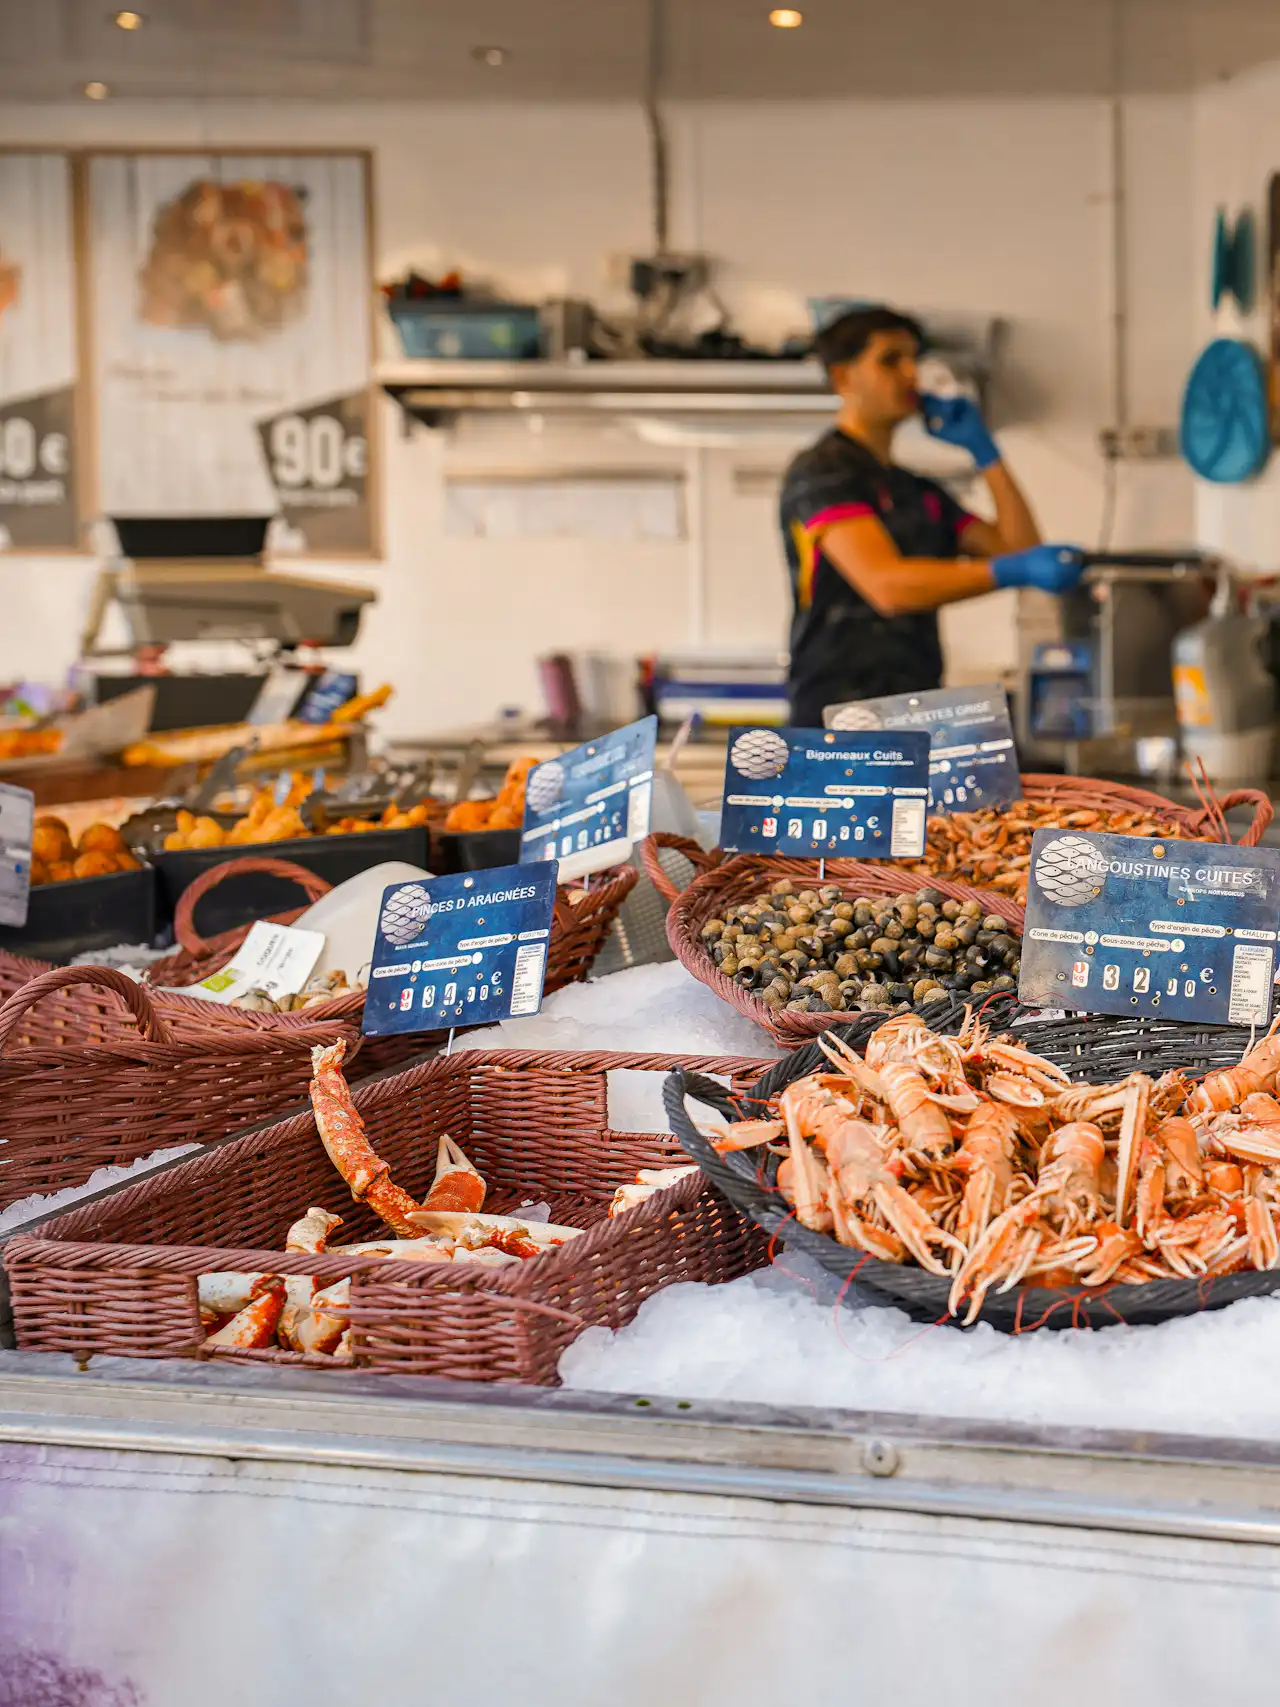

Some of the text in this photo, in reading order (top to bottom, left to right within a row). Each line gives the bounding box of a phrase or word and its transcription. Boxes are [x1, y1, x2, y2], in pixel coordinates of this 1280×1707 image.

[270, 415, 344, 488] 90
[806, 750, 904, 762] Bigorneaux Cuits
[866, 816, 880, 829] €
[1066, 857, 1254, 885] LANGOUSTINES CUITES
[412, 886, 536, 918] PINCES D ARAIGNÉES
[1152, 923, 1166, 932] Type
[1168, 924, 1190, 934] d'engin
[1200, 926, 1221, 936] pêche
[1242, 930, 1270, 939] CHALUT
[1032, 930, 1048, 938] Zone
[1049, 932, 1057, 940] de
[1058, 932, 1079, 942] pêche
[1102, 937, 1134, 946] Sous-zone
[1145, 941, 1166, 950] pêche
[491, 972, 502, 985] €
[1074, 974, 1086, 984] kg
[1200, 968, 1214, 984] €
